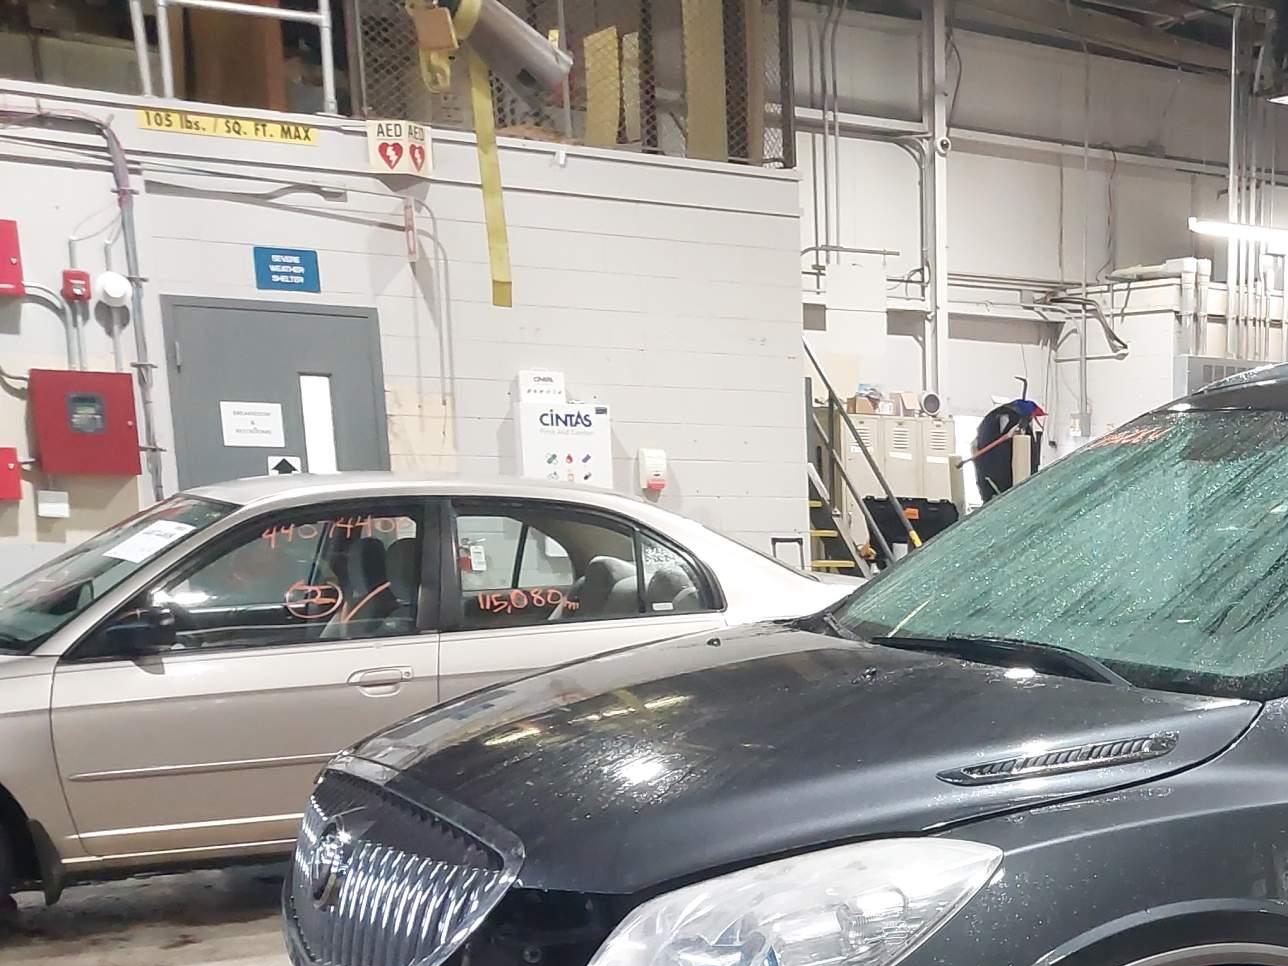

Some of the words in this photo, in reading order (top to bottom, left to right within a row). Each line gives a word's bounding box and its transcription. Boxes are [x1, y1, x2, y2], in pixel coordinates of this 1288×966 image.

[145, 111, 173, 127] 105
[180, 114, 206, 131] lbs.
[225, 120, 247, 136] SQ.
[254, 123, 273, 138] FT.
[280, 125, 312, 141] MAX
[376, 123, 402, 138] AED
[408, 125, 424, 142] AED
[539, 408, 592, 428] CINTAS
